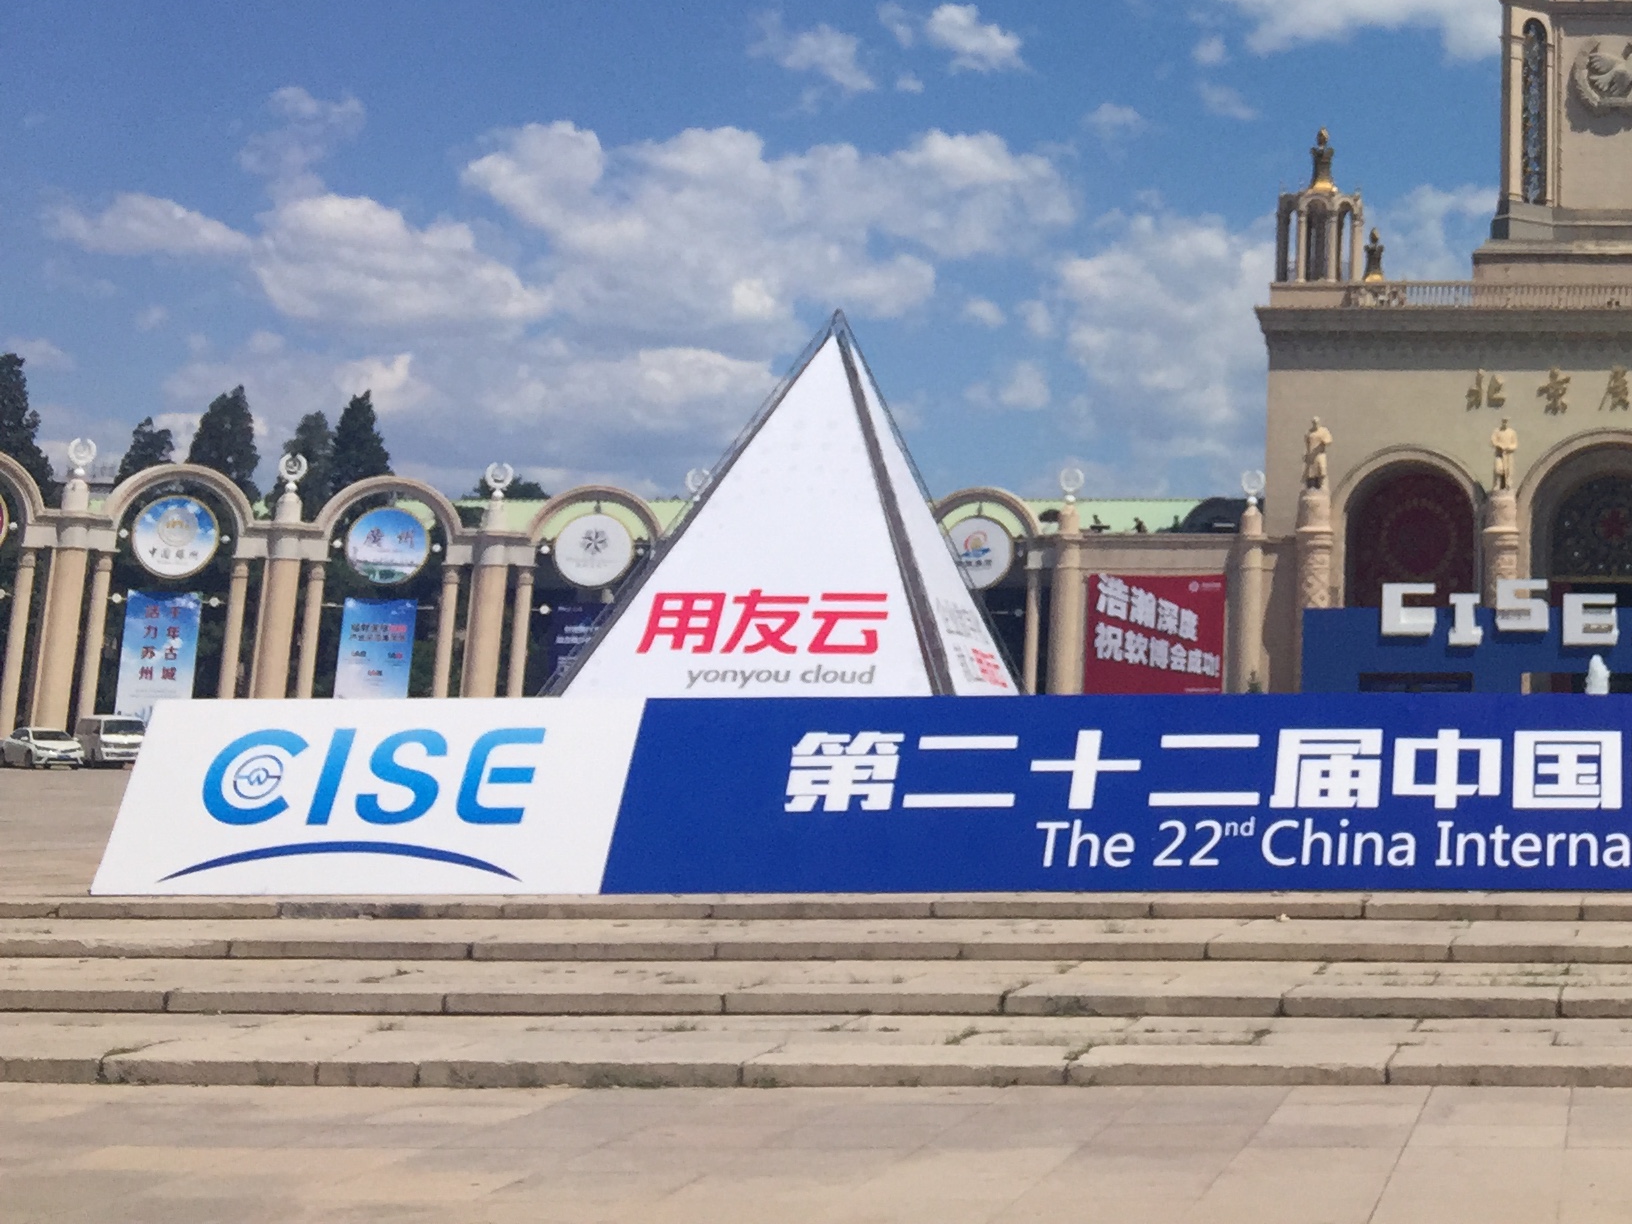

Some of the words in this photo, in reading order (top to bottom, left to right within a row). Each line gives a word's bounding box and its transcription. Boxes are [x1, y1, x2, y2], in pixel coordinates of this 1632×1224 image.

[637, 588, 889, 655] 用友云
[1096, 573, 1199, 642] 浩瀚深度
[685, 666, 791, 689] yonyou
[799, 663, 877, 687] cloud
[202, 726, 547, 826] CISE
[1036, 820, 1135, 867] The
[1152, 818, 1256, 867] 22nd
[1262, 819, 1415, 867] China
